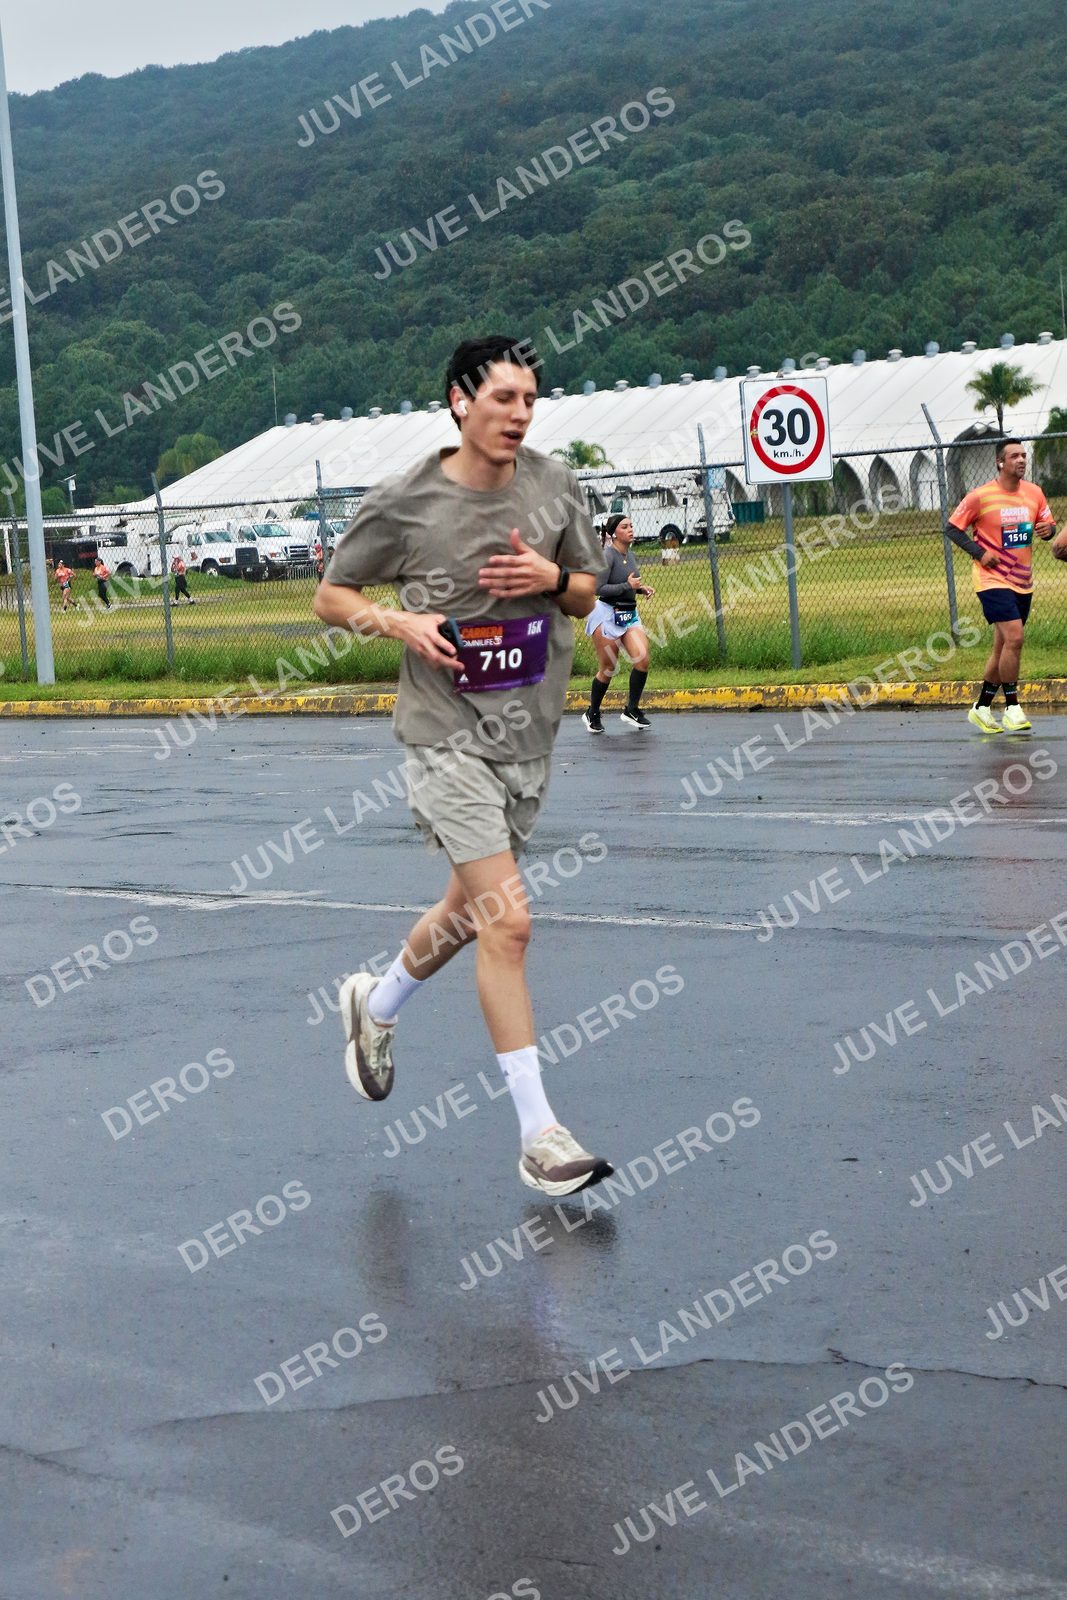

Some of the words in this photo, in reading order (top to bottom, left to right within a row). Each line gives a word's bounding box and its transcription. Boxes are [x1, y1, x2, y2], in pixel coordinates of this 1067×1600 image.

[763, 407, 811, 446] 30
[773, 448, 805, 459] km./h.
[1008, 533, 1028, 542] 1516
[527, 619, 544, 635] 15K
[480, 648, 522, 671] 710
